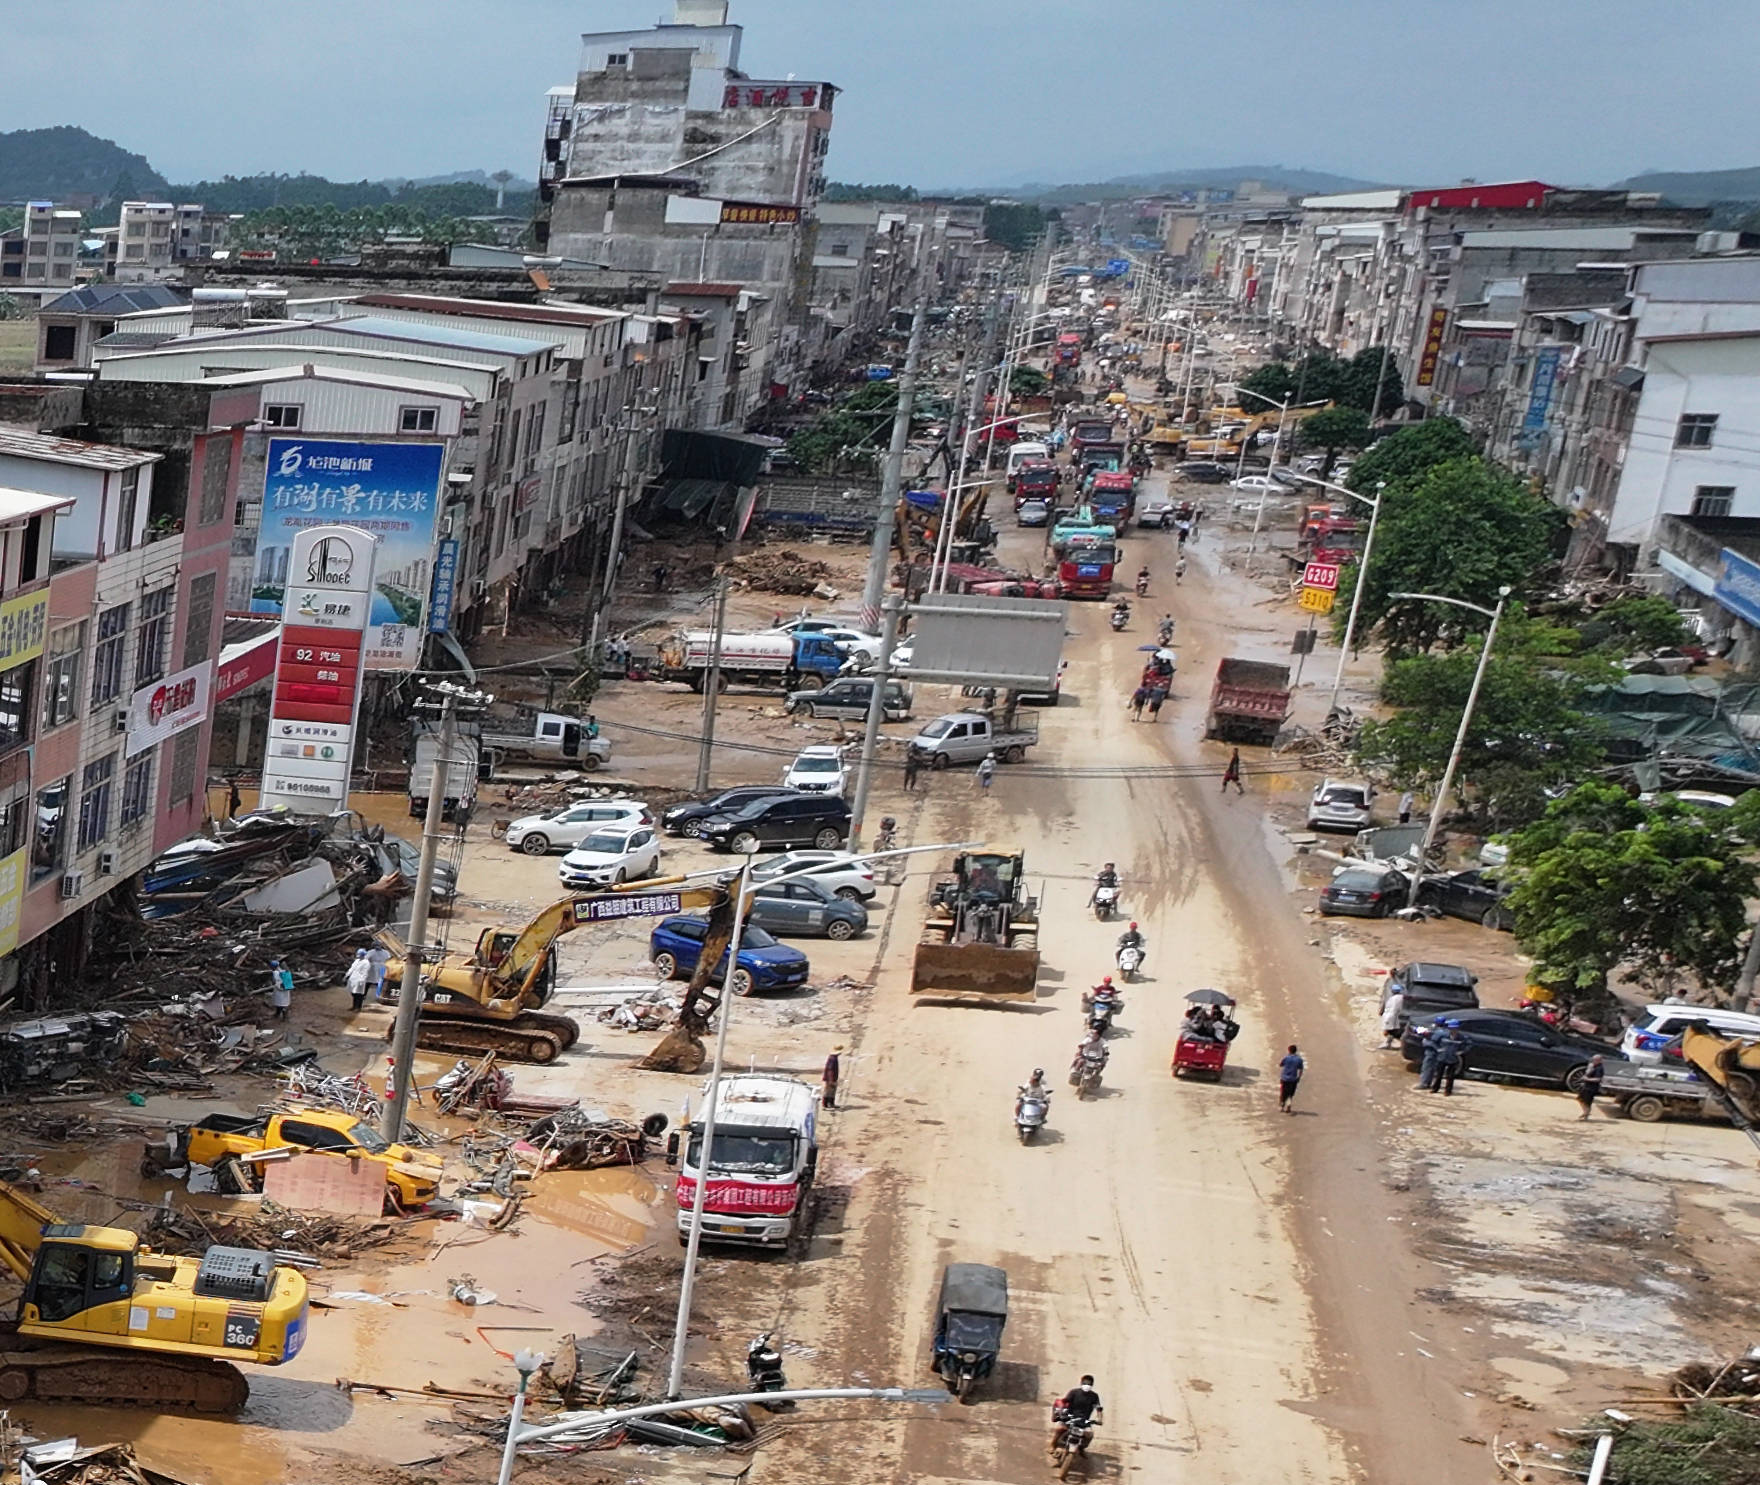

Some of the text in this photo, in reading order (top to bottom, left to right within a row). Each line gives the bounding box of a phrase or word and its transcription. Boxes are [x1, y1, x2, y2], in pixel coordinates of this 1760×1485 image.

[272, 481, 429, 515] 有湖有景有未来
[1307, 567, 1336, 584] G209
[296, 648, 313, 661] 92
[433, 992, 452, 1003] CAT
[227, 1324, 243, 1333] PC
[226, 1333, 256, 1346] 360
